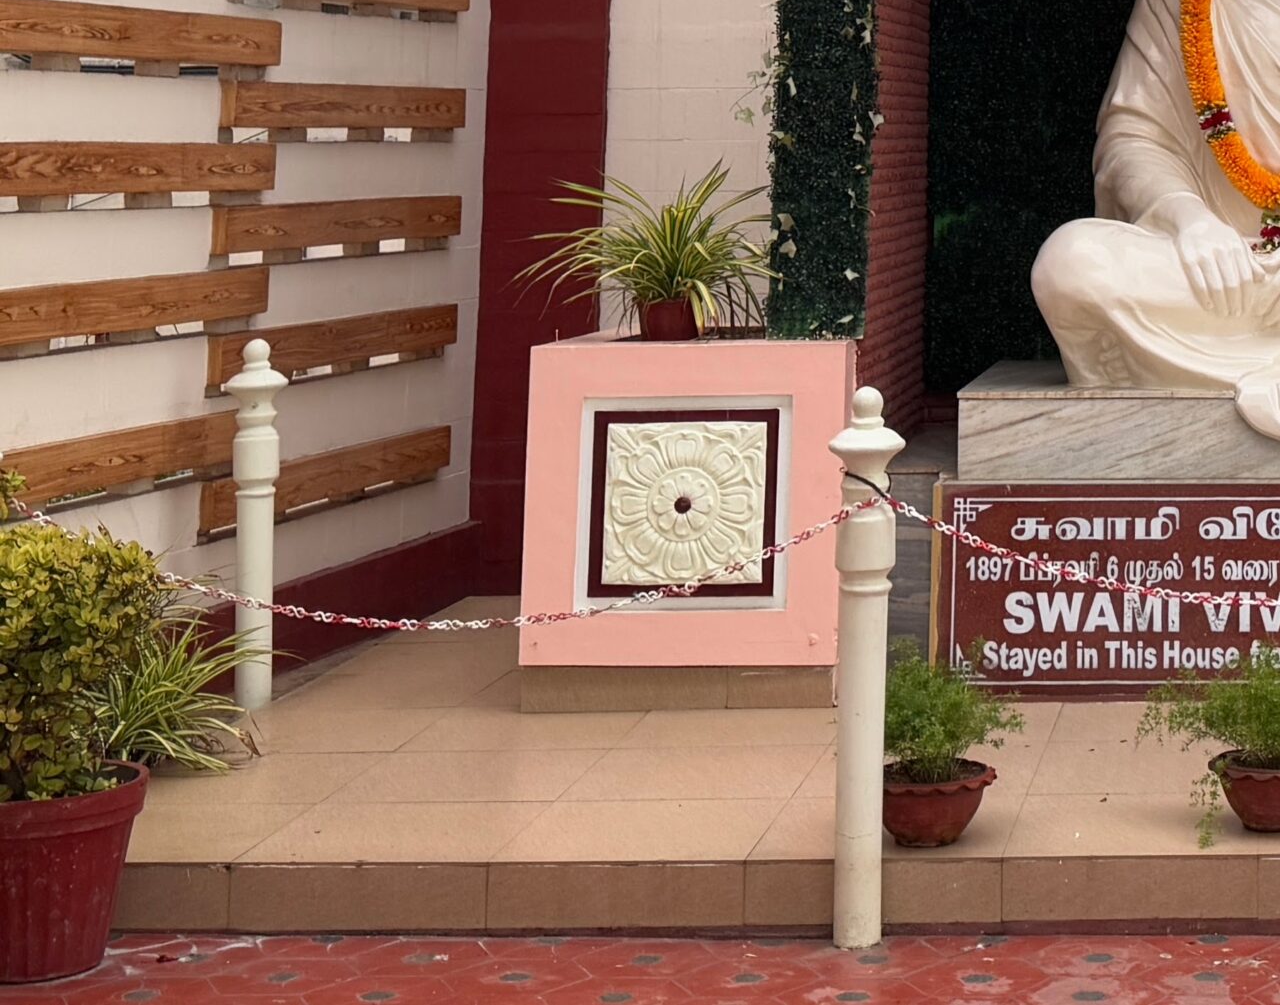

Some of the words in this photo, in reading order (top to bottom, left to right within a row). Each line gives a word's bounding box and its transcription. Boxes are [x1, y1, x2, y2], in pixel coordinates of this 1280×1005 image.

[1010, 505, 1180, 541] சுவாமி
[965, 556, 1013, 582] 1897
[1106, 555, 1119, 582] 6
[1124, 551, 1184, 588] முதல்
[1191, 555, 1216, 582] 15
[1221, 558, 1280, 588] வரை
[1003, 591, 1181, 635] SWAMI
[982, 640, 1068, 677] Stayed
[1076, 640, 1098, 669] in
[1104, 640, 1158, 669] This
[1163, 640, 1240, 670] House
